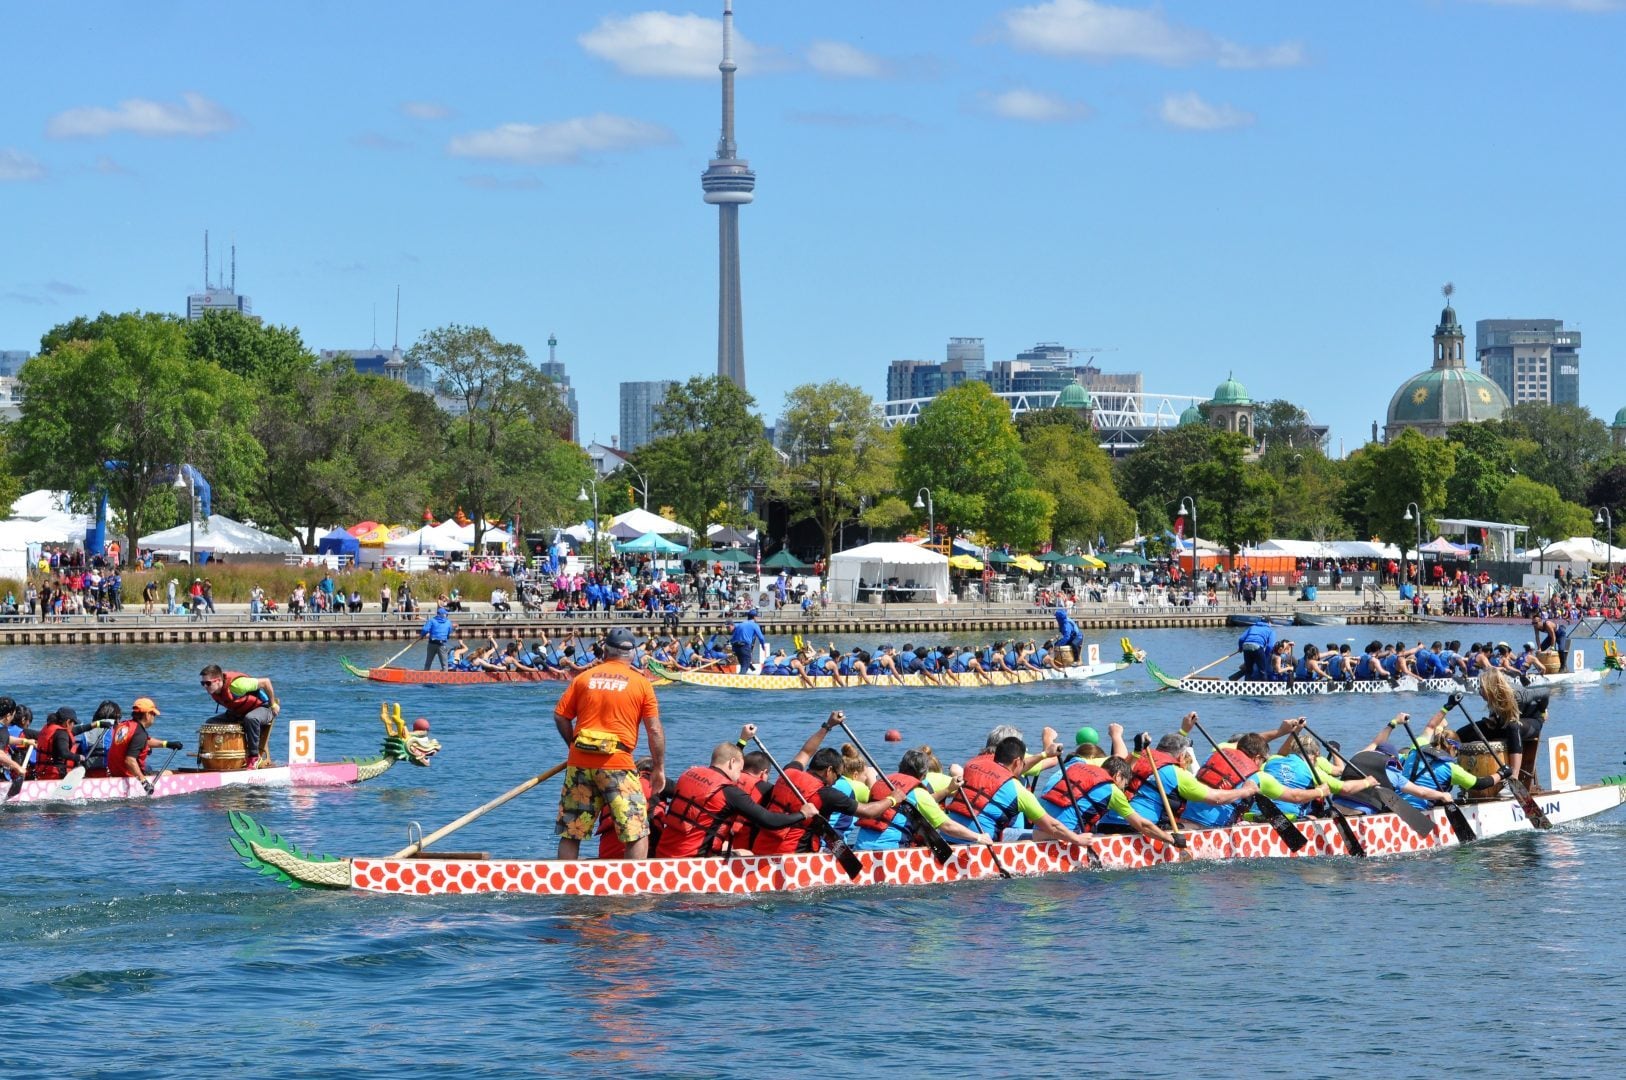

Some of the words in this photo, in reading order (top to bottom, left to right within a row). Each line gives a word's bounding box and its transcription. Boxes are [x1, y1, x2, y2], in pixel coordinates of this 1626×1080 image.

[1091, 647, 1097, 661] 2
[1576, 652, 1582, 668] 3
[588, 680, 629, 692] STAFF
[295, 725, 309, 756] 5
[1555, 742, 1569, 780] 6
